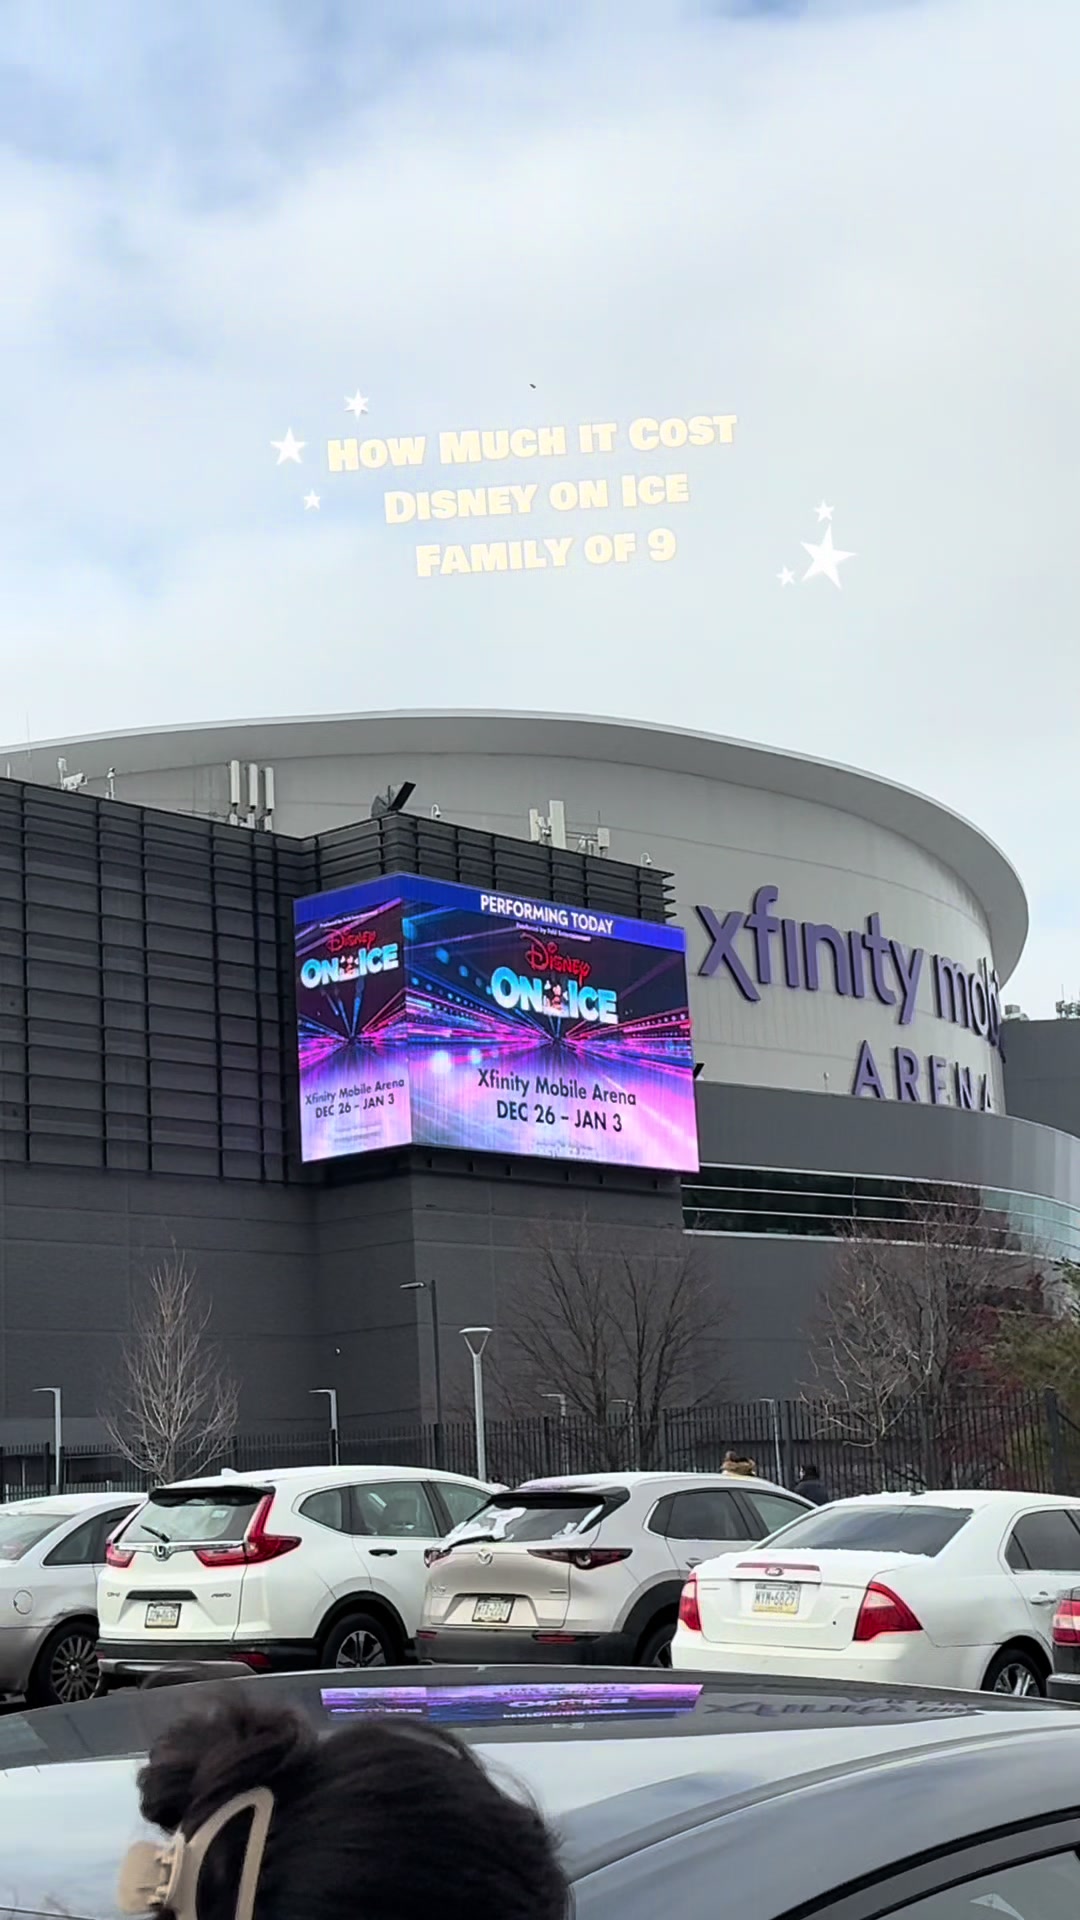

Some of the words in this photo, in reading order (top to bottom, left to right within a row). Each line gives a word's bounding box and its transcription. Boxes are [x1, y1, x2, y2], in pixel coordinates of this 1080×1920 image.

[480, 894, 568, 926] PERFORMING
[571, 912, 614, 934] TODAY
[300, 957, 339, 989] ON
[358, 943, 399, 976] ICE
[696, 885, 924, 1025] xfinity
[491, 966, 543, 1013] ON
[567, 979, 619, 1025] ICE
[305, 1091, 336, 1105] Xfinity
[339, 1083, 372, 1098] Mobile
[375, 1079, 405, 1091] Arena
[478, 1068, 530, 1098] Xfinity
[535, 1075, 587, 1100] Mobile
[592, 1083, 637, 1105] Arena
[852, 1039, 996, 1112] ARENA
[315, 1104, 334, 1118] DEC
[338, 1102, 351, 1115] 26
[363, 1095, 384, 1110] JAN
[388, 1093, 395, 1105] 3
[497, 1100, 528, 1122] DEC
[534, 1104, 556, 1125] 26
[574, 1109, 607, 1130] JAN
[613, 1113, 622, 1132] 3
